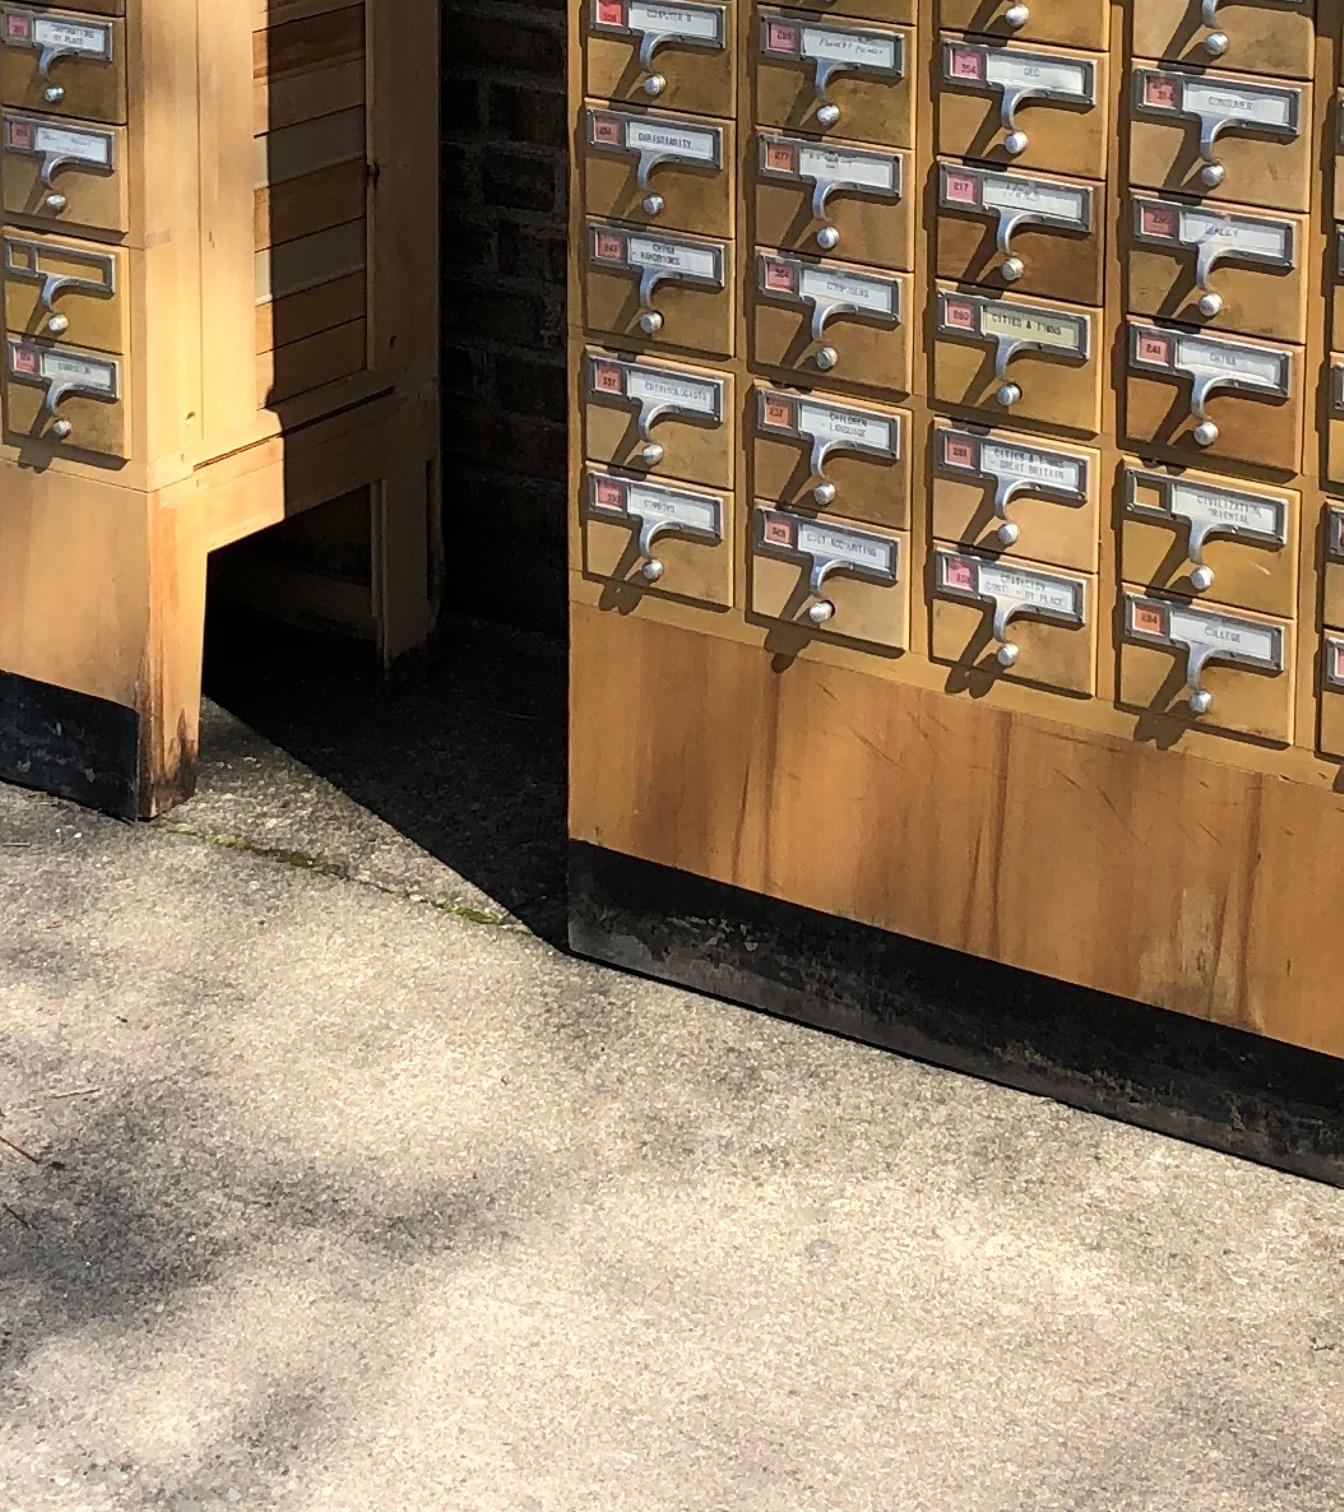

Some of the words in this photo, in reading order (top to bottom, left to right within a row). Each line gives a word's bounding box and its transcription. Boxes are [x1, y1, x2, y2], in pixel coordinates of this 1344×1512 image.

[1209, 97, 1251, 111] CONSUMER
[639, 133, 693, 149] CHRISTIANITY
[992, 313, 1021, 328] CITIES
[1037, 322, 1062, 335] TOWNS
[1000, 461, 1025, 473] GREAT
[1029, 465, 1064, 479] BRITAIN
[807, 534, 826, 547] COST
[831, 538, 877, 557] ACCOUNTING
[1204, 628, 1241, 642] COLLEGE
